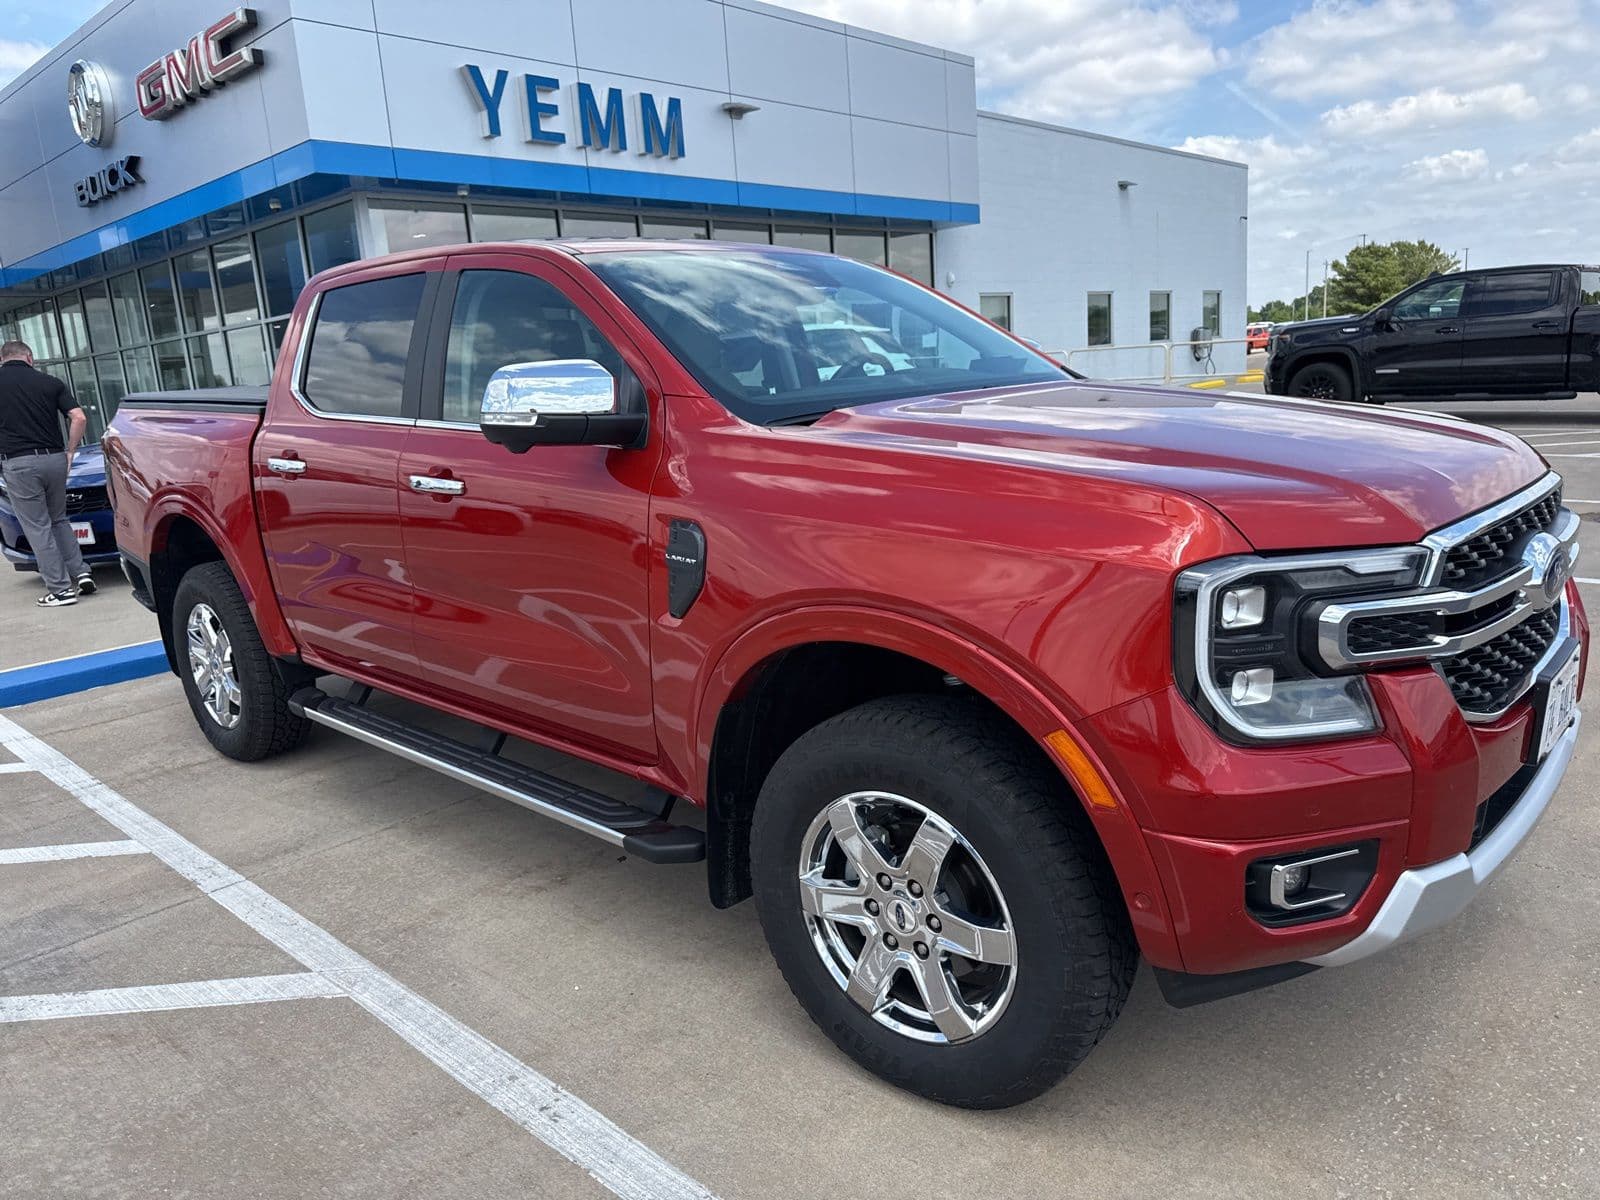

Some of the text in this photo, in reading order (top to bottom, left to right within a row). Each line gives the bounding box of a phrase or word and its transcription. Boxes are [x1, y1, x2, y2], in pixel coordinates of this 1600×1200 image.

[136, 6, 264, 121] GMC
[458, 64, 686, 160] YEMM
[73, 155, 146, 208] BUICK
